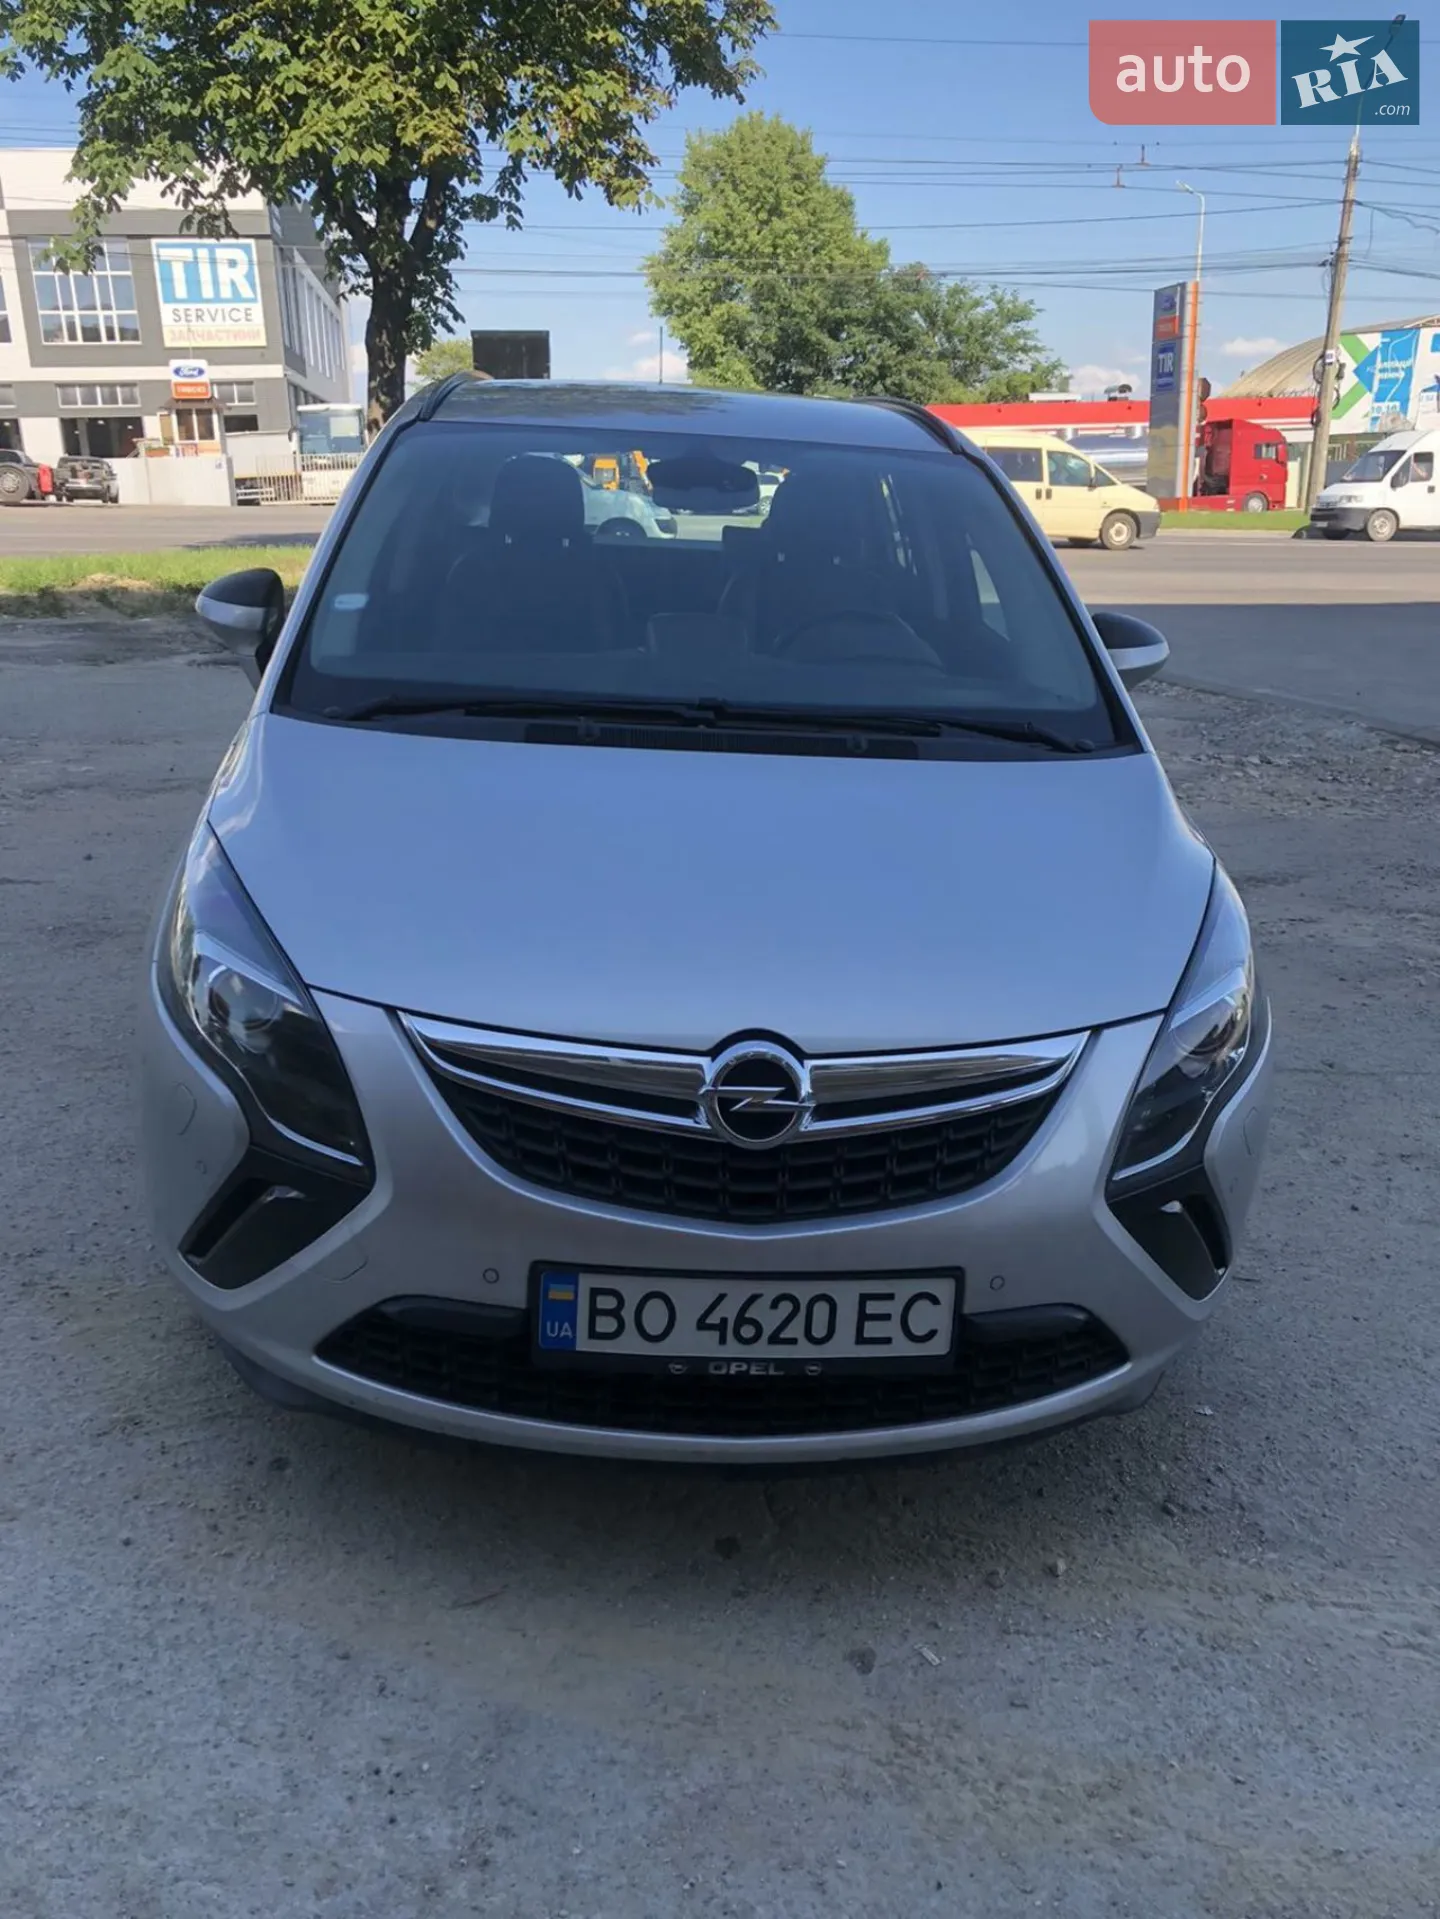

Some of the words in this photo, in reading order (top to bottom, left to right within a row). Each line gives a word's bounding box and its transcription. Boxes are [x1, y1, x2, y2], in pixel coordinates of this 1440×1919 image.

[158, 247, 256, 299] TIR
[171, 307, 253, 323] SERVICE
[1158, 352, 1174, 373] TIR
[586, 1286, 677, 1343] BO
[695, 1292, 838, 1346] 4620
[853, 1291, 942, 1346] EC
[546, 1320, 574, 1338] UA
[707, 1361, 786, 1376] OPEL
